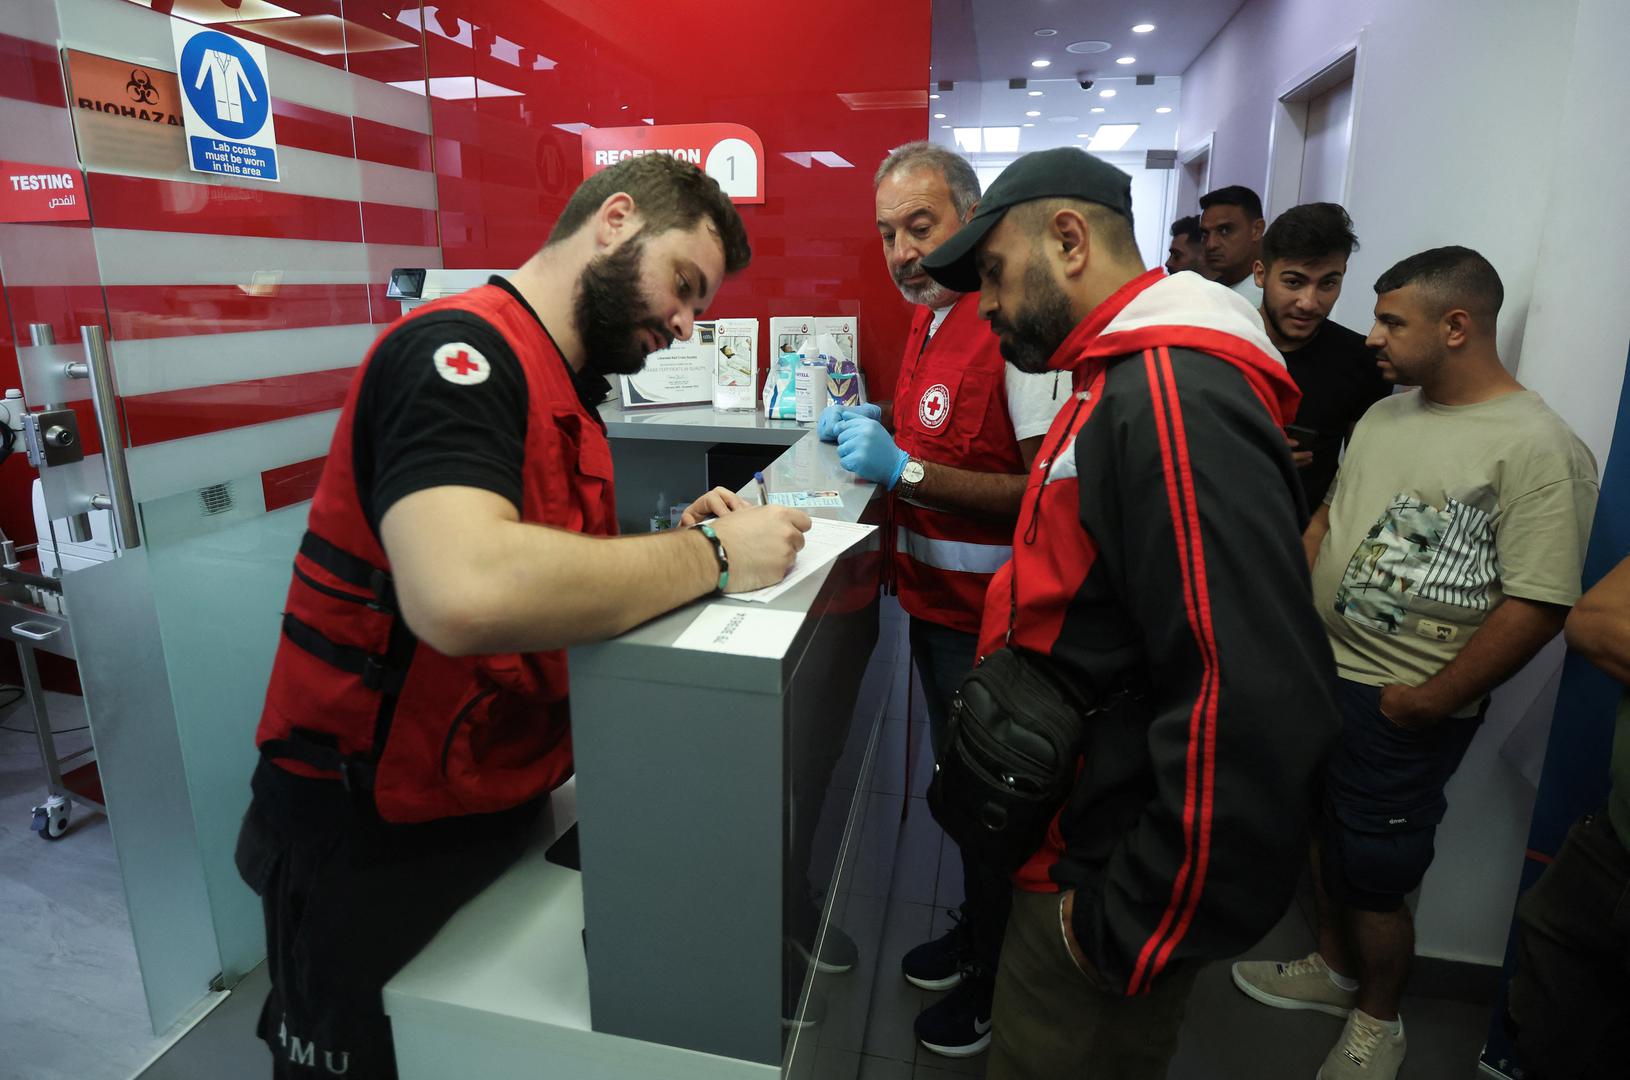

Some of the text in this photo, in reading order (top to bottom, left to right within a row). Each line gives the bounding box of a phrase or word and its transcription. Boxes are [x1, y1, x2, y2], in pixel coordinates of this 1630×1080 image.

[212, 140, 257, 156] Lab coats
[205, 151, 266, 167] must be worn
[212, 161, 262, 176] in this area
[726, 155, 735, 181] 1
[10, 173, 74, 191] TESTING
[48, 194, 76, 209] الفحص
